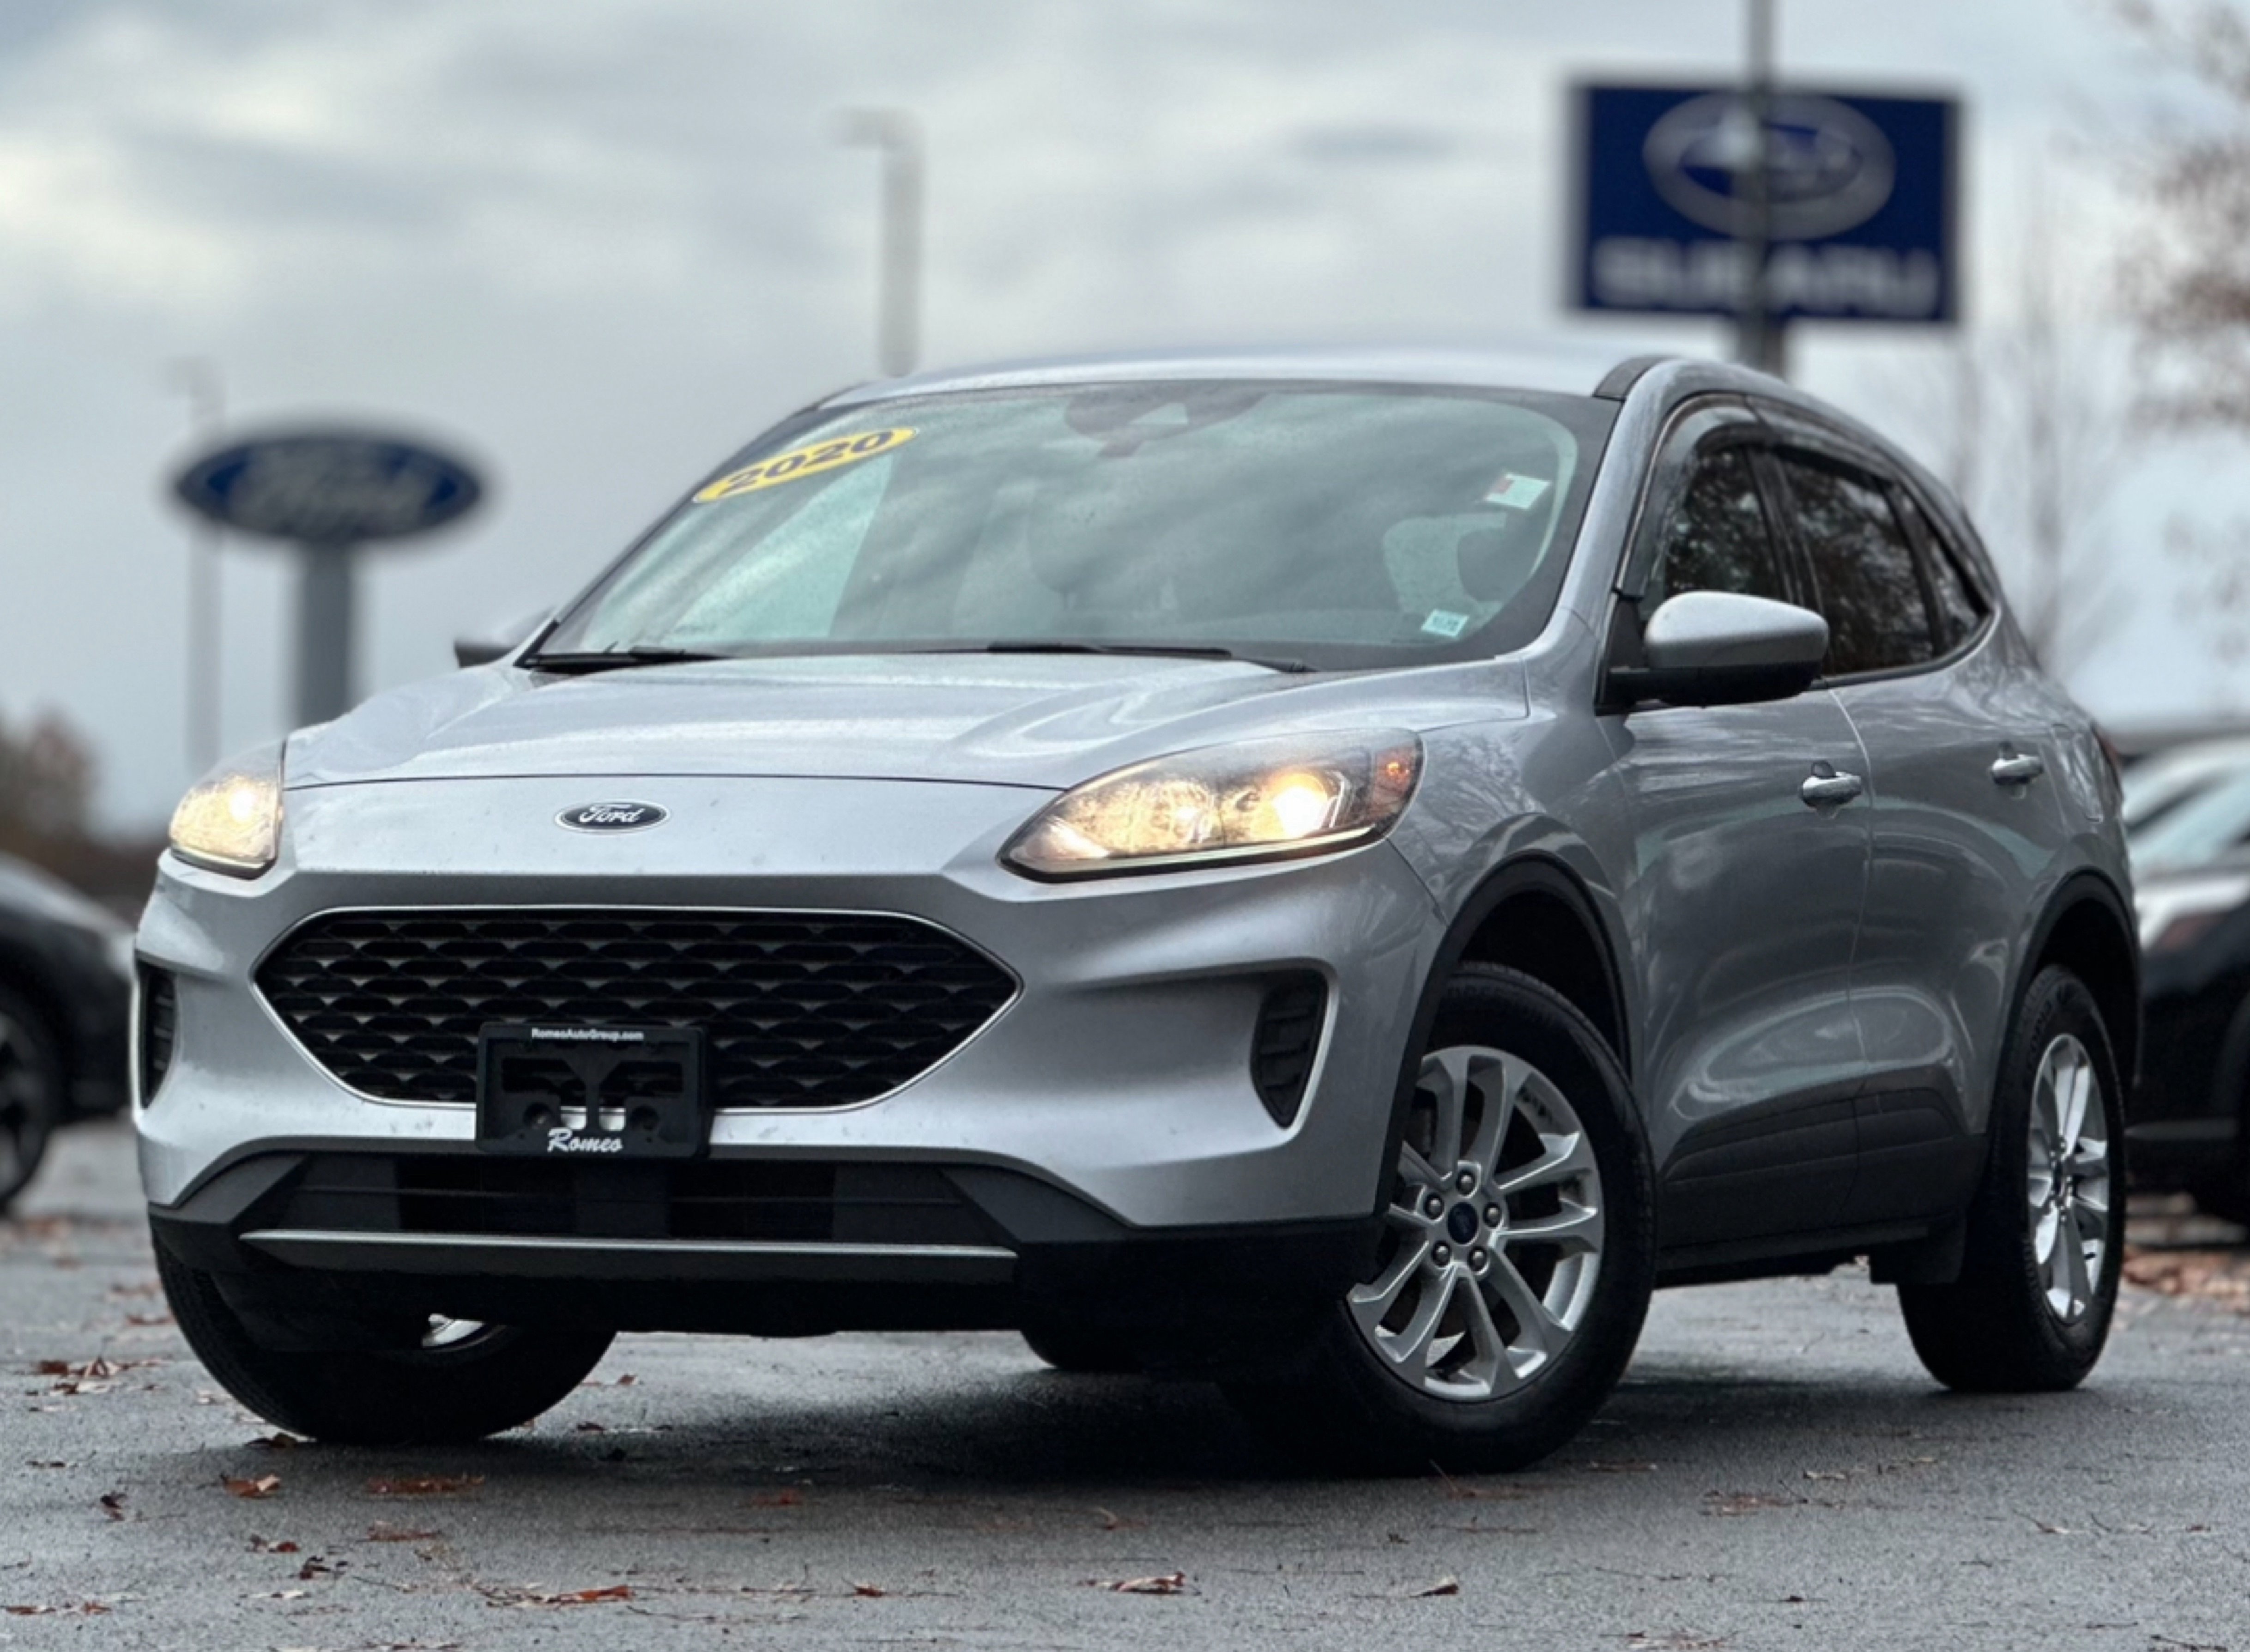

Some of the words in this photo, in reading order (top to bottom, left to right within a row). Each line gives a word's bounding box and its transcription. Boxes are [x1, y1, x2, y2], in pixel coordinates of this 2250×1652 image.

[716, 431, 894, 496] 2020
[579, 804, 646, 823] Ford
[547, 1127, 623, 1153] Romeo
